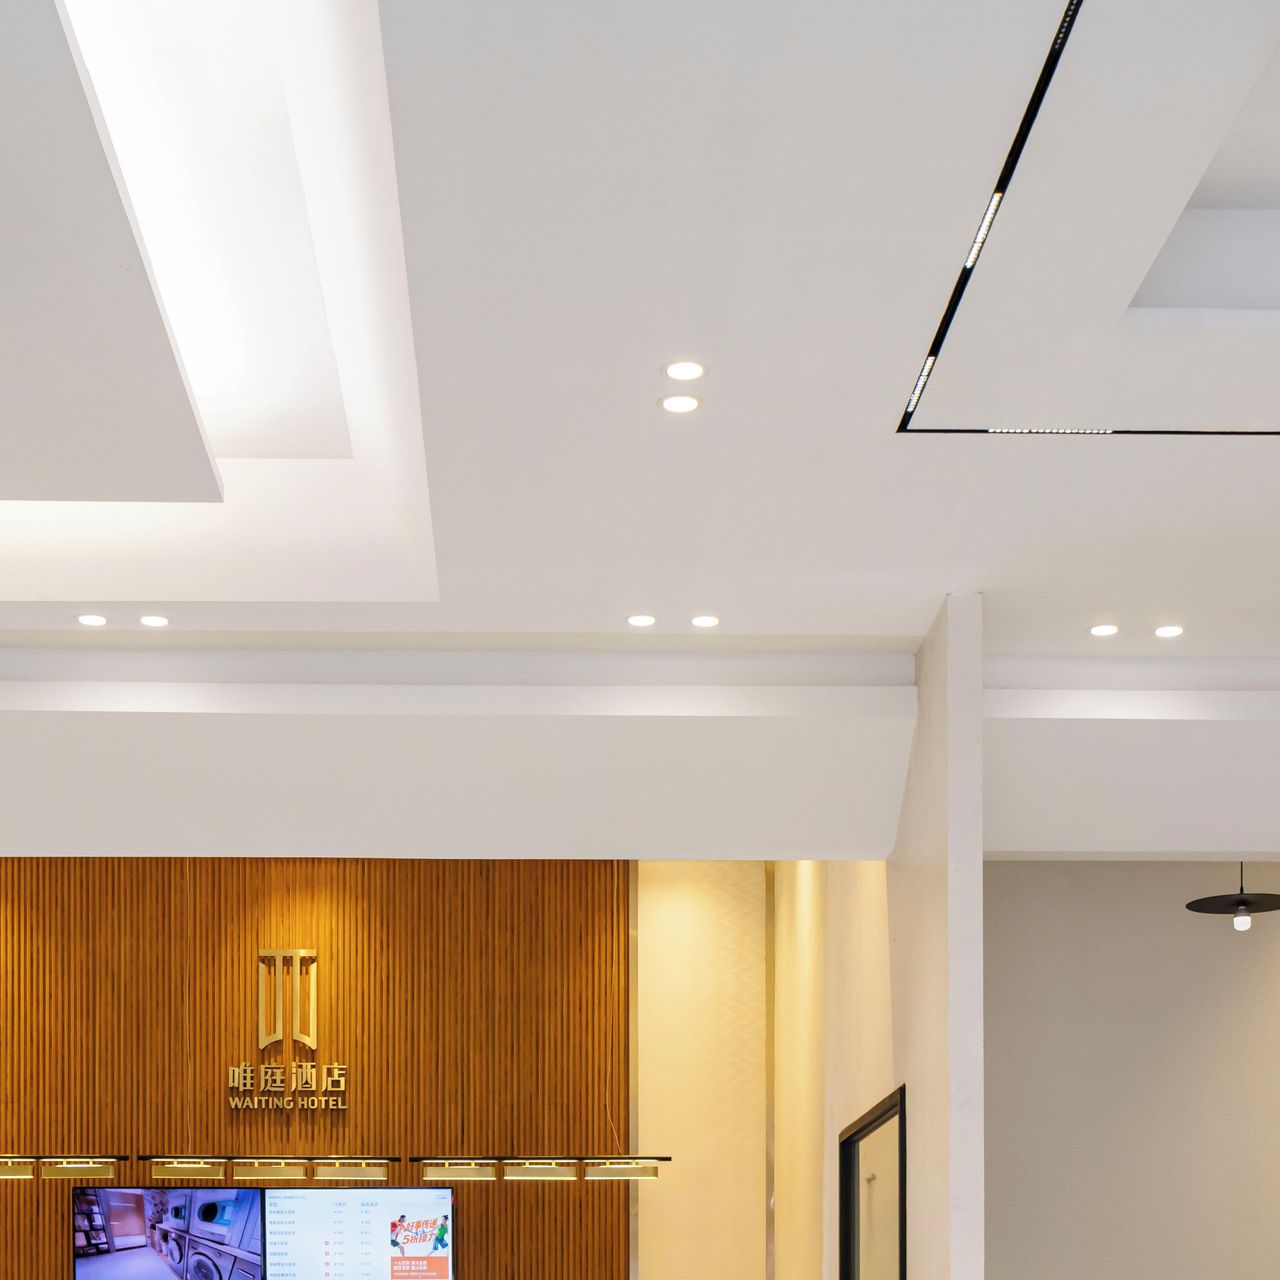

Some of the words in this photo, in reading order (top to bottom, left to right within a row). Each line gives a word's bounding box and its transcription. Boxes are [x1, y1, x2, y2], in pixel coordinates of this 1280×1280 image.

[229, 1061, 347, 1092] 唯庭酒店
[229, 1097, 293, 1109] WAITING
[298, 1097, 347, 1109] HOTEL
